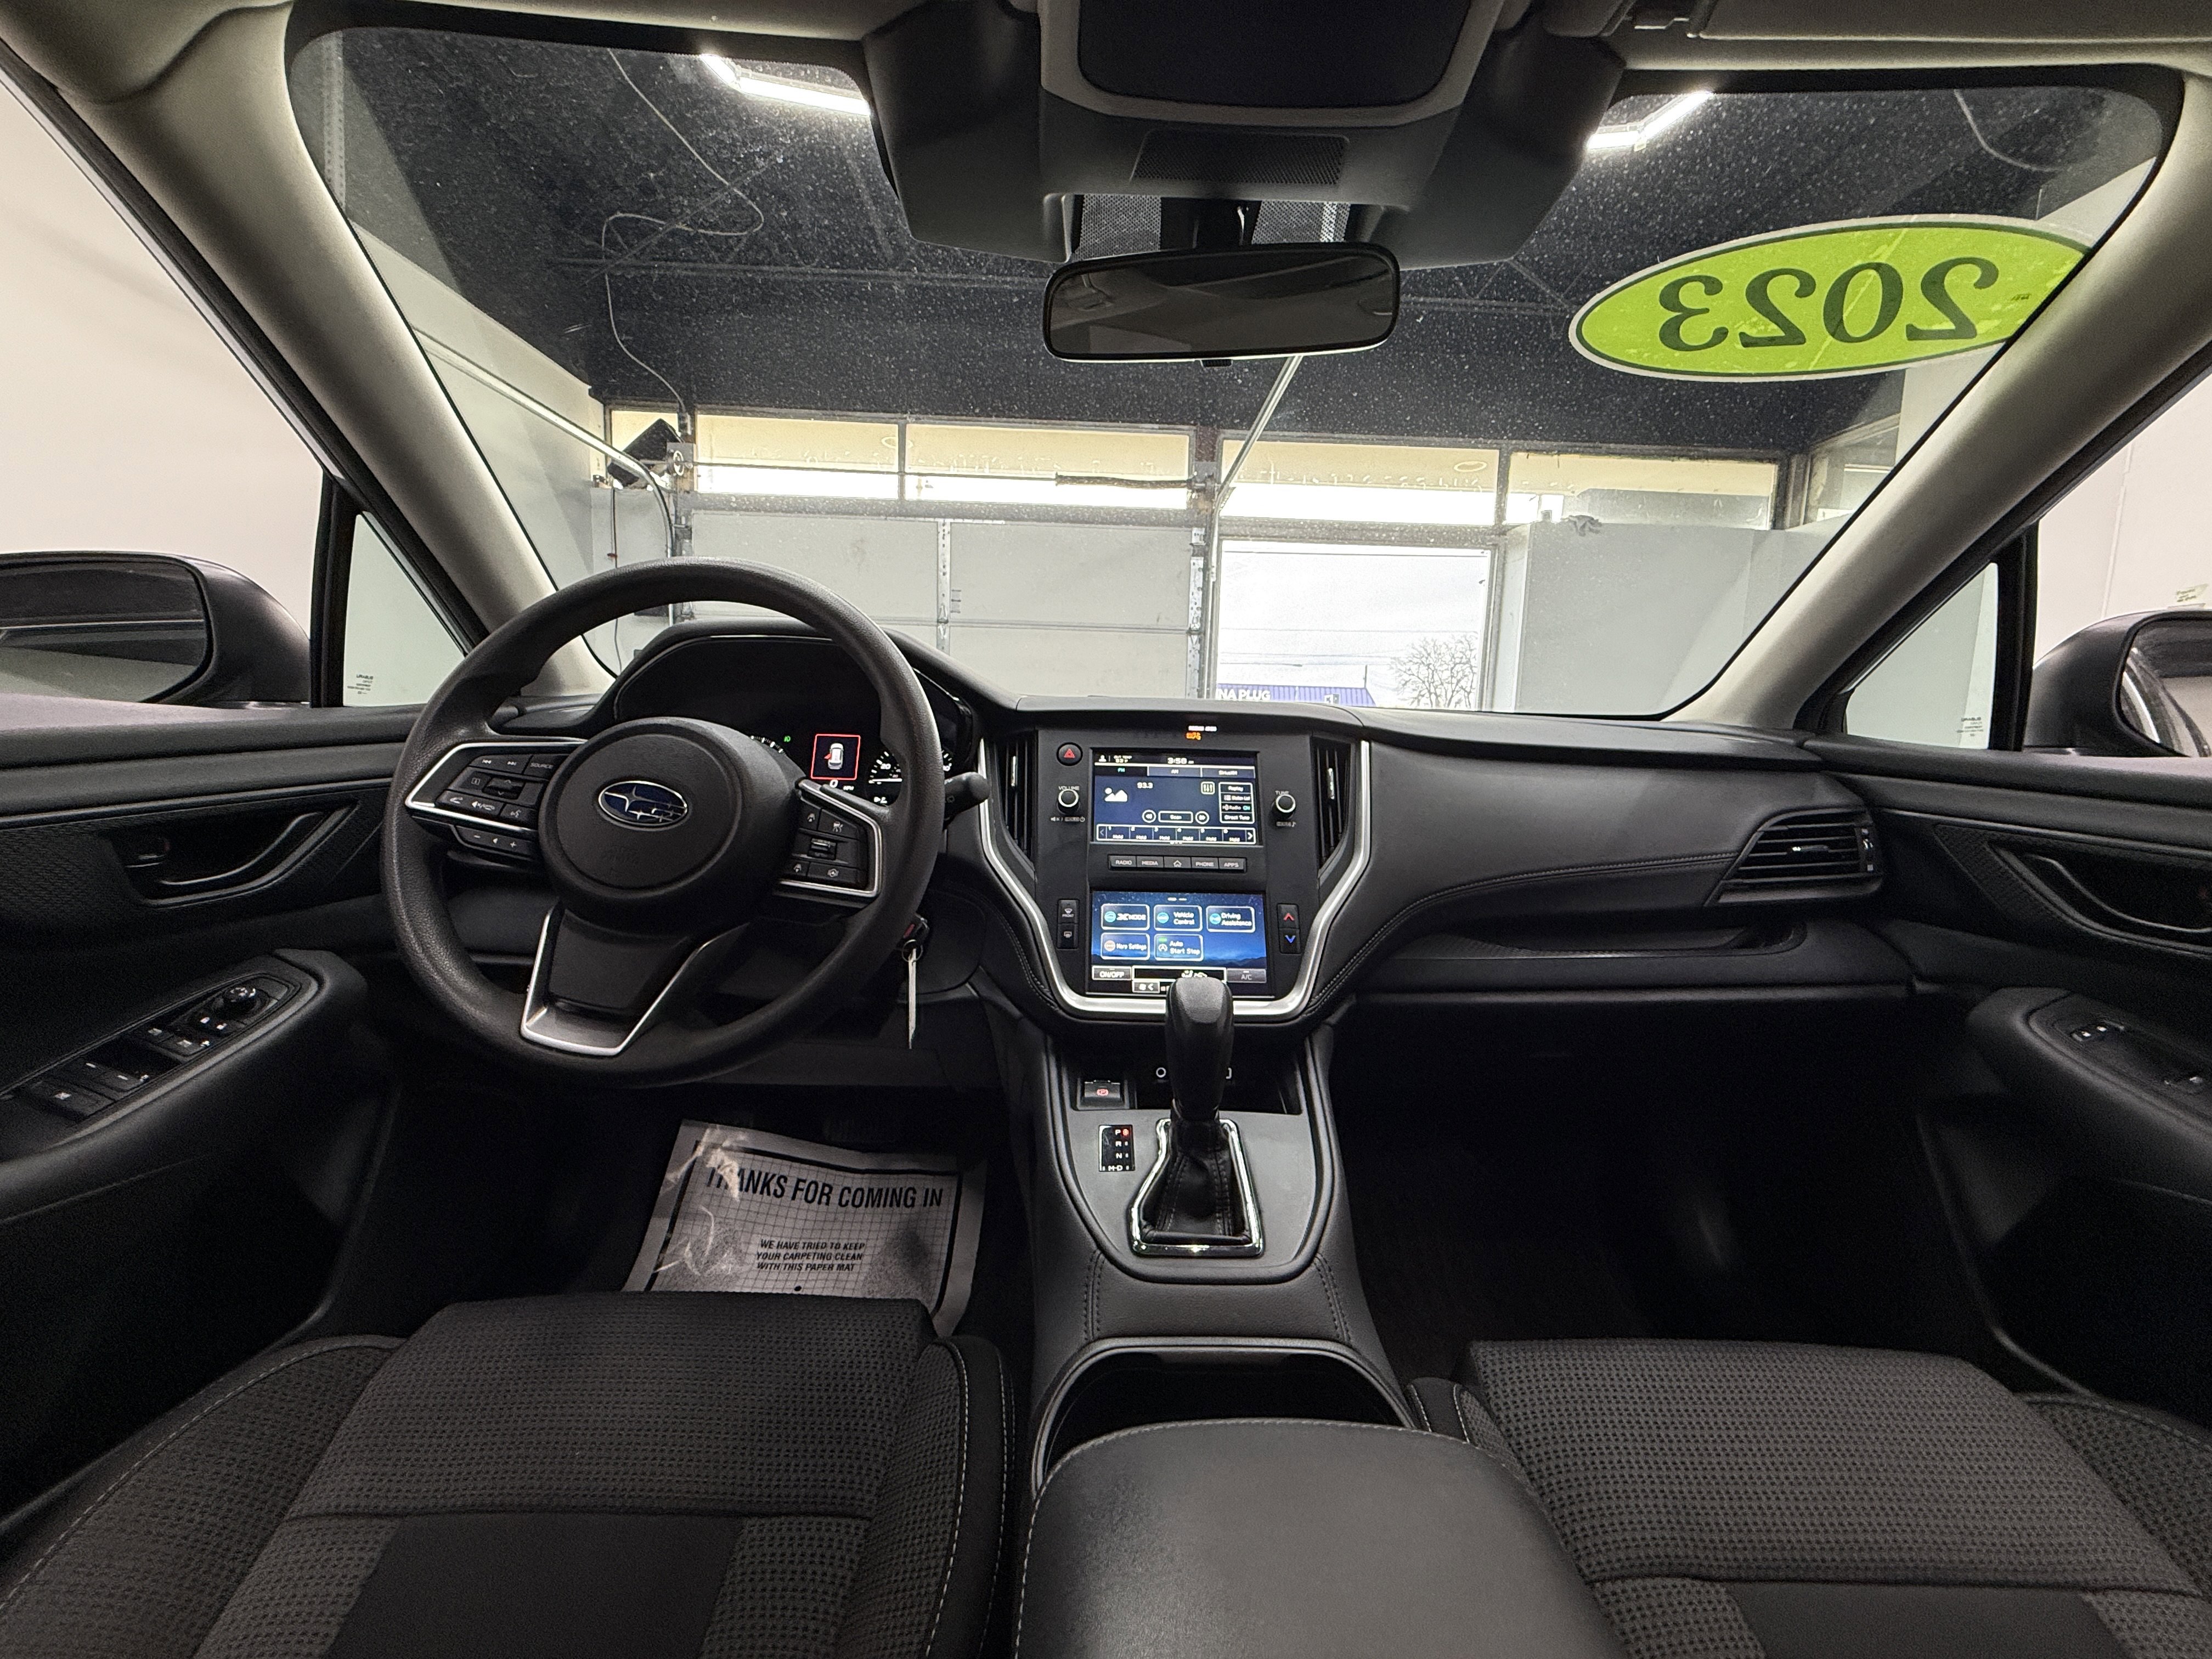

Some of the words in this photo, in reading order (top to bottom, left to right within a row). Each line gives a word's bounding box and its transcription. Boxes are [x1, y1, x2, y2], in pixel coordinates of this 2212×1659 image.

[1239, 690, 1271, 701] PLUG
[791, 1178, 833, 1206] FOR
[838, 1186, 916, 1208] COMING
[923, 1188, 944, 1207] IN
[760, 1239, 775, 1249] WE
[776, 1240, 800, 1250] HAVE
[801, 1242, 827, 1250] TRIED
[757, 1252, 780, 1260] YOUR
[783, 1252, 832, 1261] CARPETING
[834, 1252, 863, 1261] CLEAN
[757, 1262, 781, 1270] WITH
[783, 1263, 803, 1271] THIS
[805, 1263, 834, 1271] PAPER
